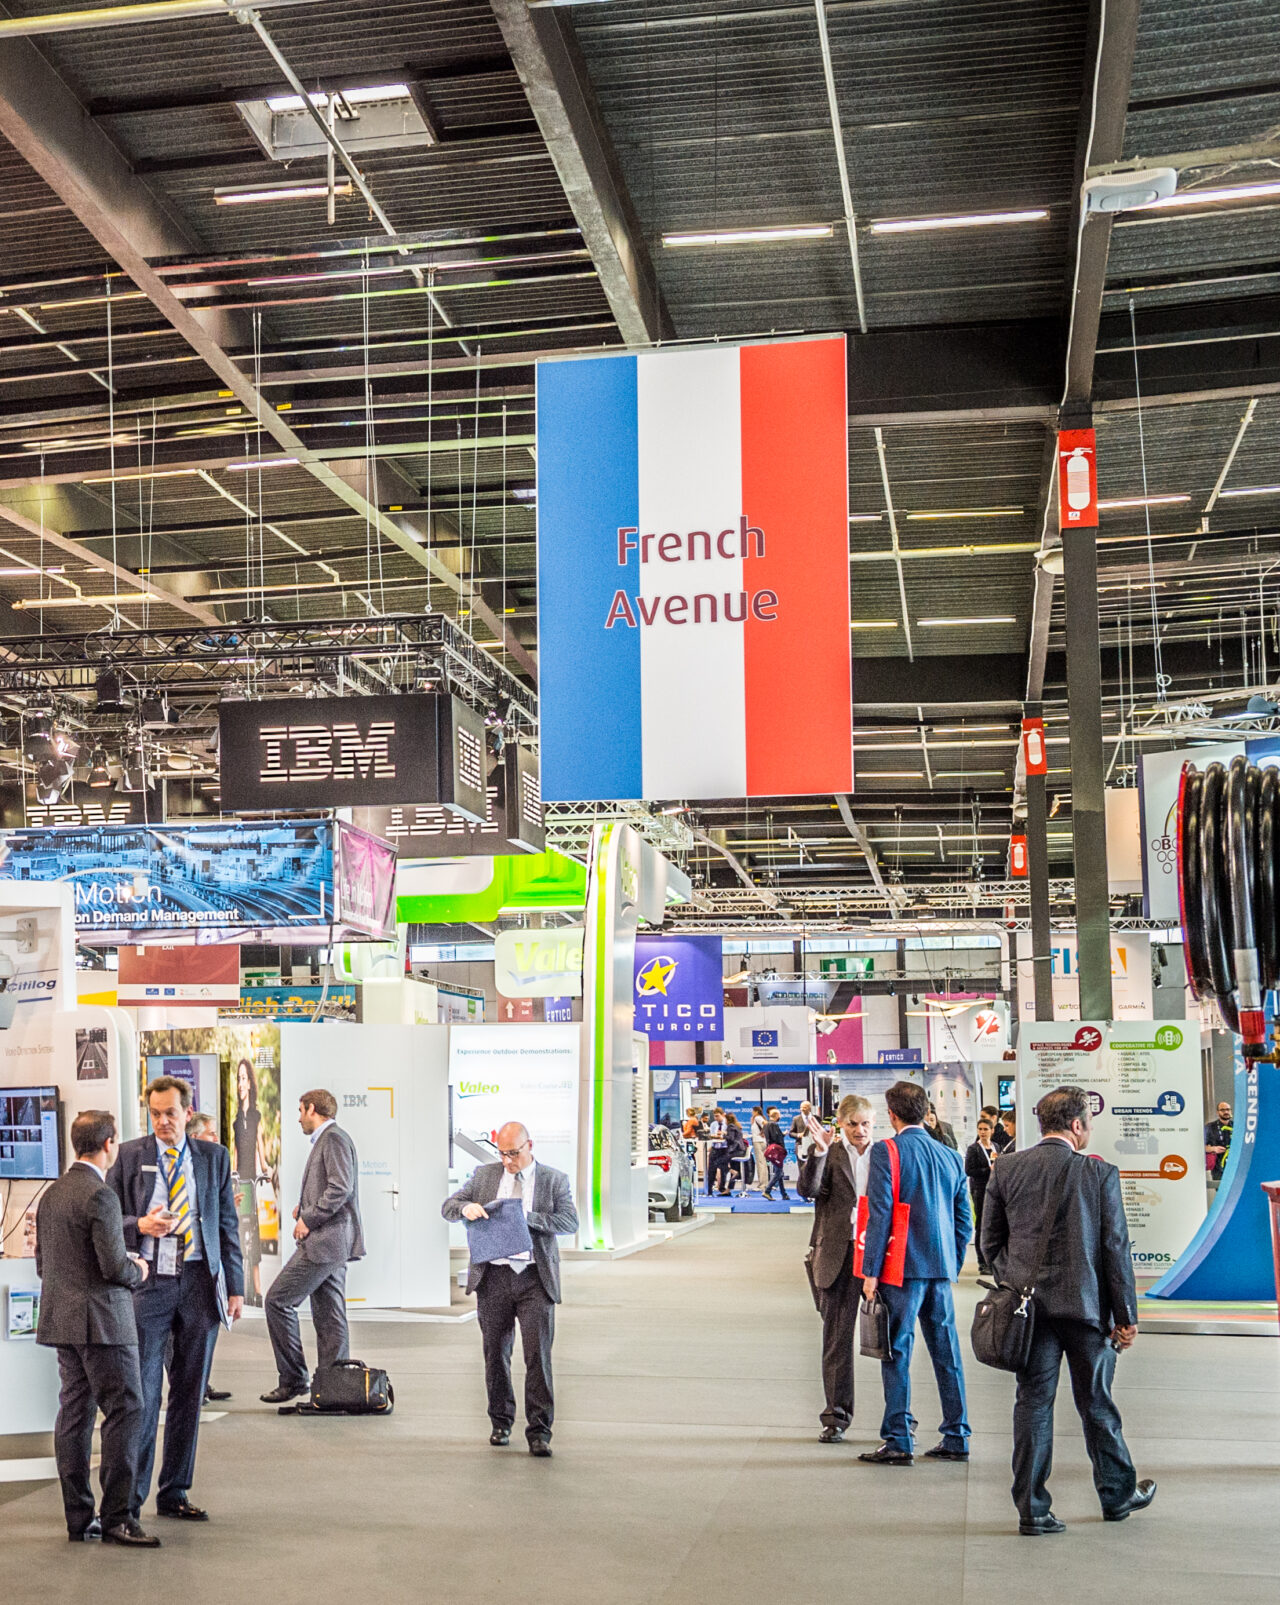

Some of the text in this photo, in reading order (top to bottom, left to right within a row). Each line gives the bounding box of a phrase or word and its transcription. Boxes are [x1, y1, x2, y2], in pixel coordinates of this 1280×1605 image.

[617, 514, 766, 566] French
[604, 588, 779, 630] Avenue
[259, 721, 396, 783] IBM
[457, 725, 482, 793] IBM
[93, 909, 148, 924] Demand
[150, 908, 239, 925] Management
[514, 941, 582, 972] Vale
[633, 1004, 716, 1018] TICO
[644, 1023, 717, 1031] EUROPE
[459, 1080, 500, 1094] Valeo
[343, 1094, 368, 1108] IBM
[1245, 1062, 1258, 1145] RENDS
[1132, 1253, 1171, 1262] TOPOS
